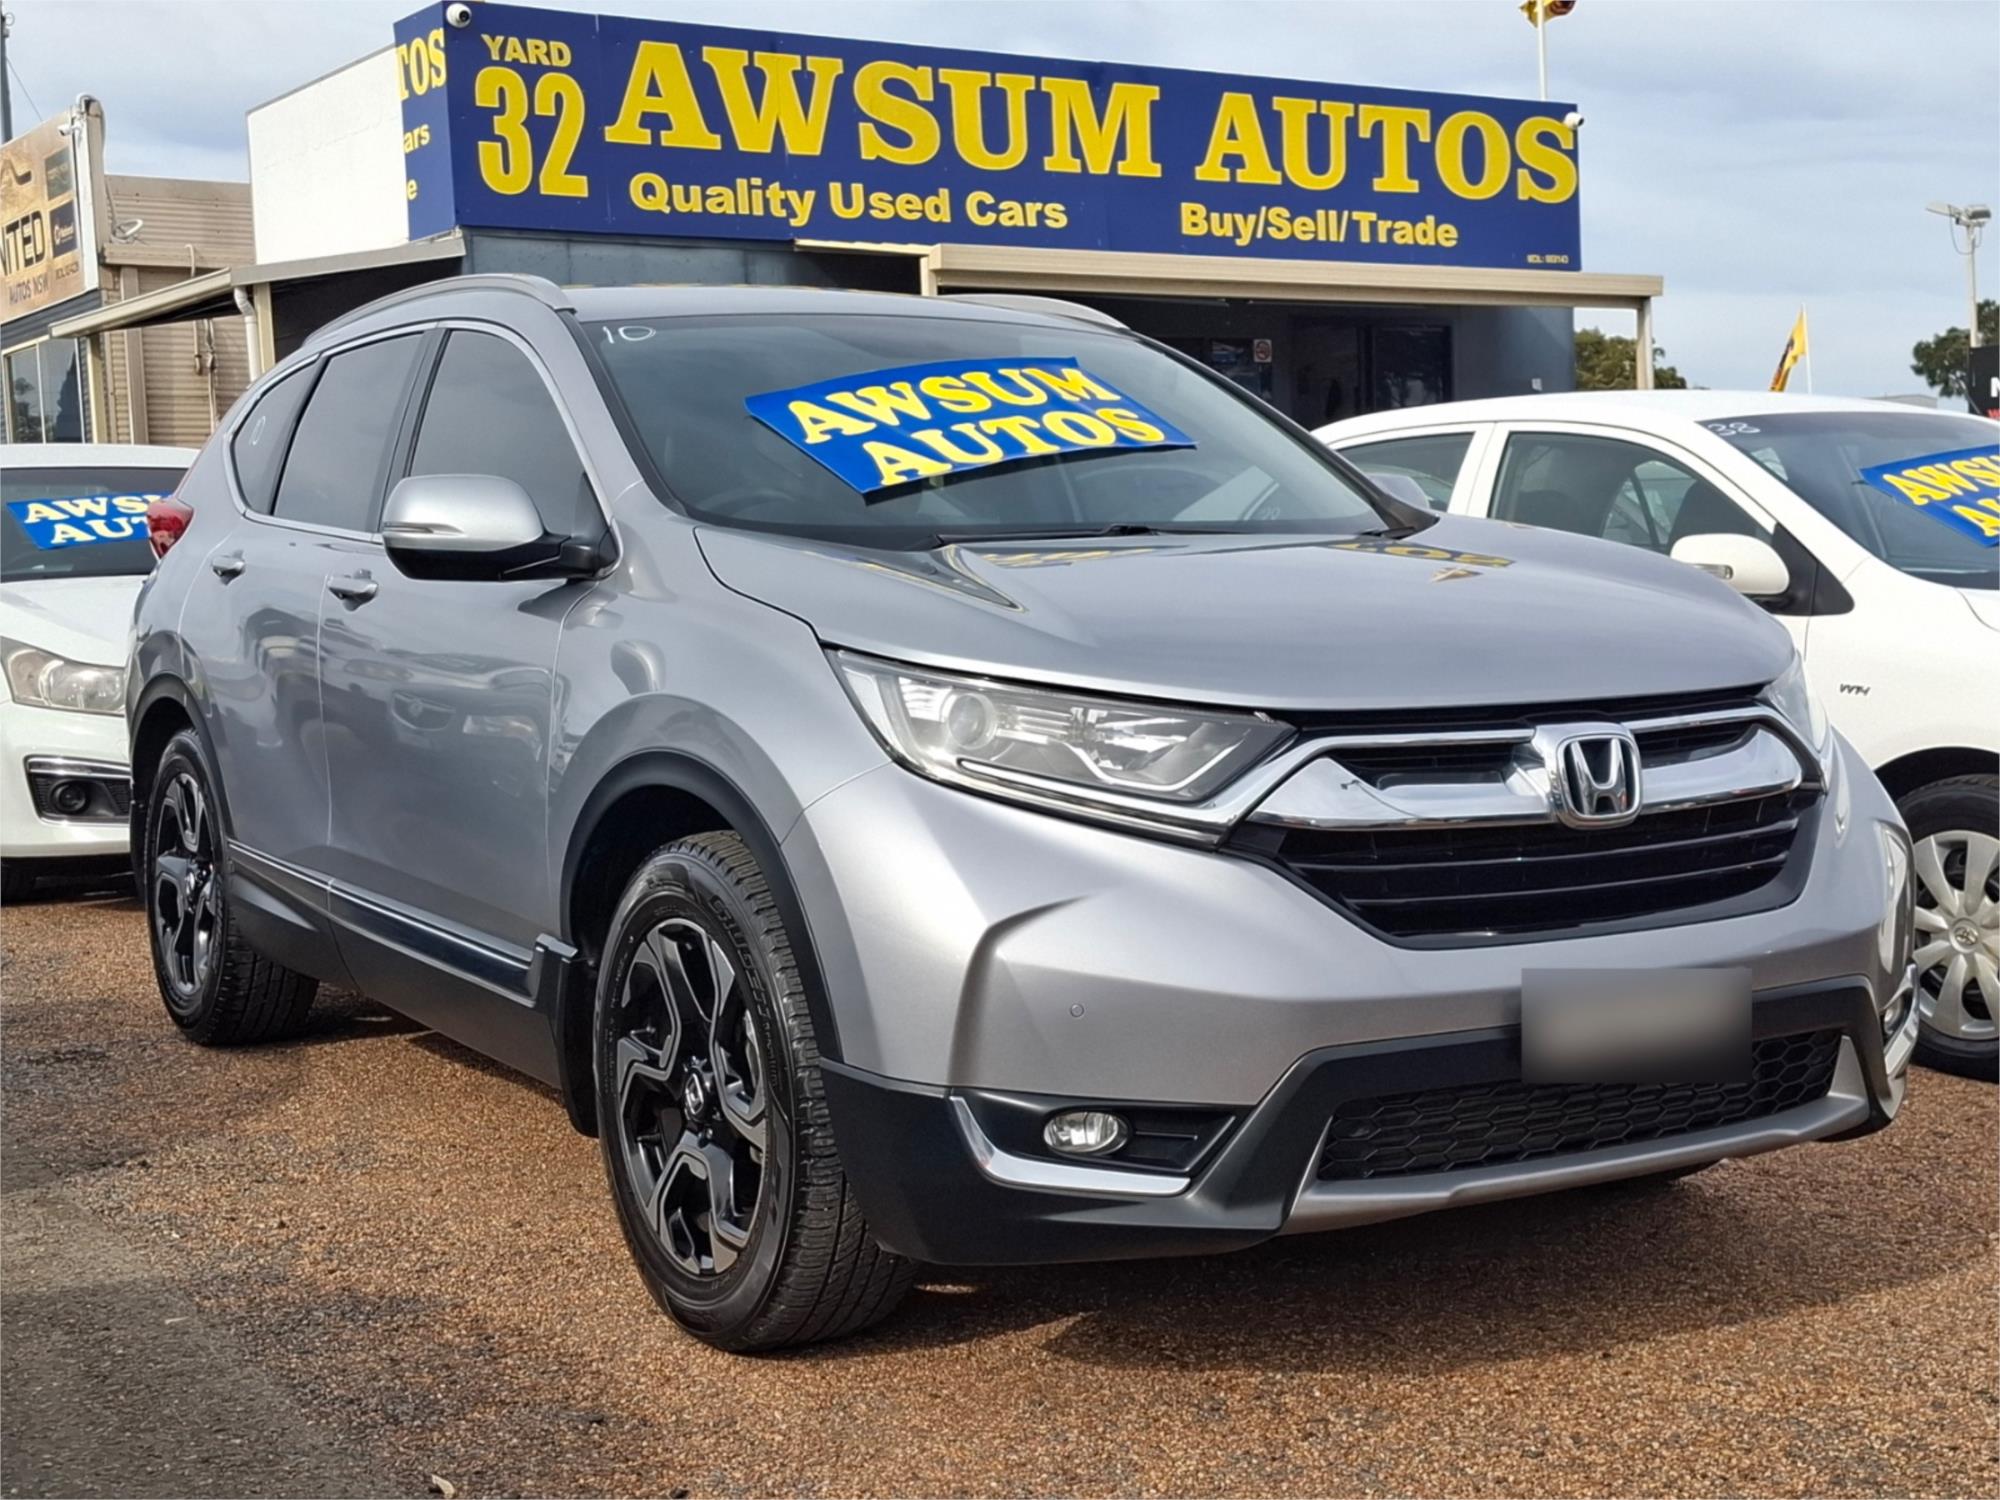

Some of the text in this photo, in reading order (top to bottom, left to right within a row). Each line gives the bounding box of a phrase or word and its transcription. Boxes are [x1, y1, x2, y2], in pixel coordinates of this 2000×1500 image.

[483, 35, 572, 68] YARD
[474, 67, 589, 198] 32
[603, 39, 1578, 203] AWSUM AUTOS
[629, 172, 1068, 229] Quality Used Cars
[1180, 202, 1459, 247] Buy/Sell/Trade
[787, 367, 1121, 445] AWSUM
[861, 407, 1165, 487] AUTOS
